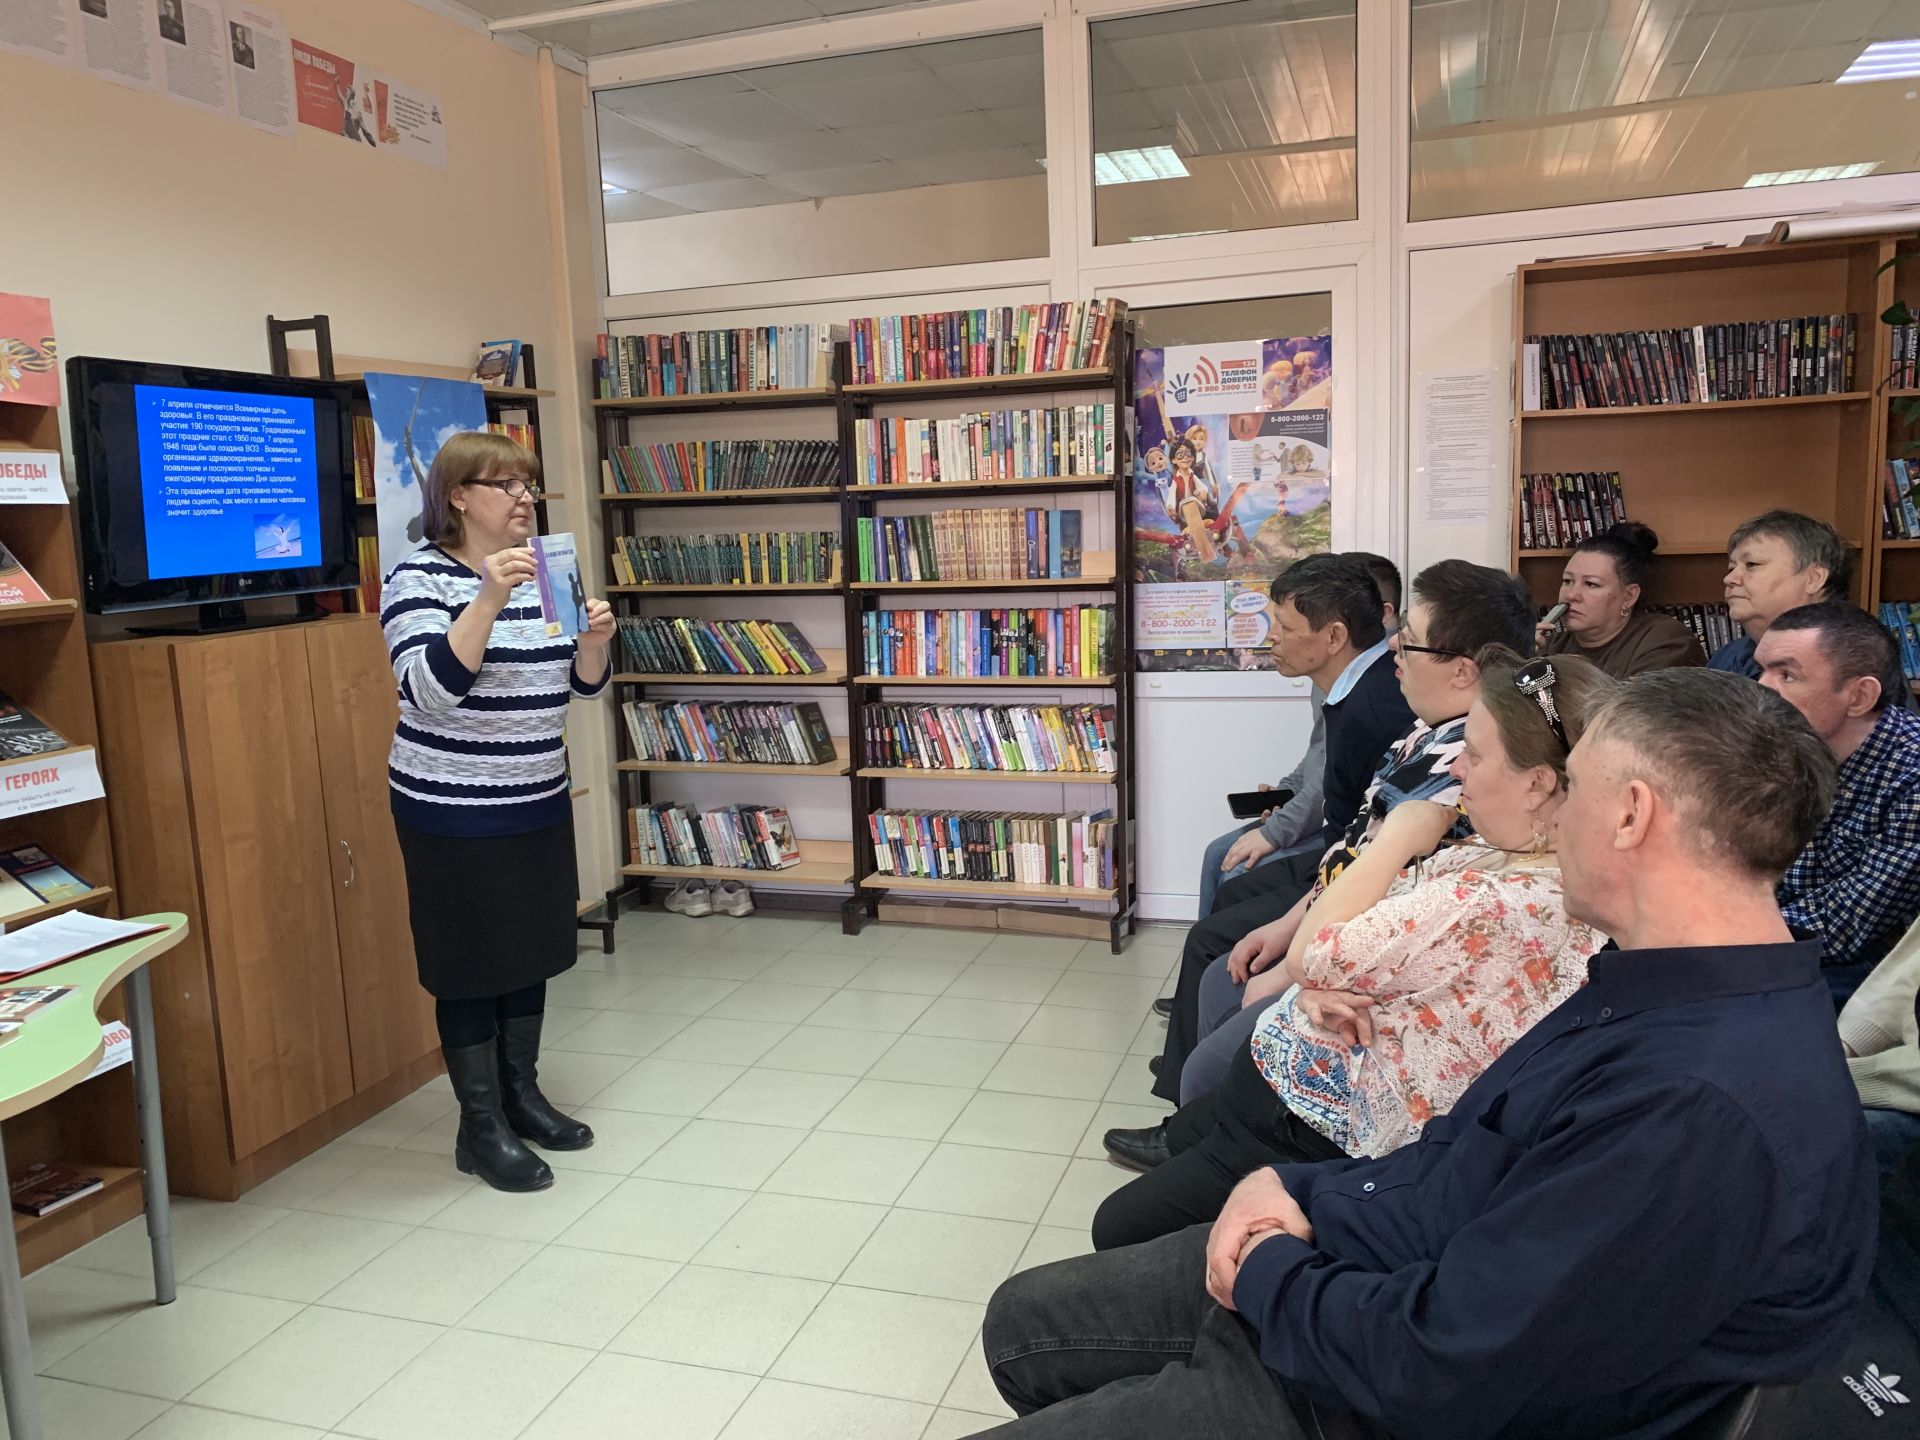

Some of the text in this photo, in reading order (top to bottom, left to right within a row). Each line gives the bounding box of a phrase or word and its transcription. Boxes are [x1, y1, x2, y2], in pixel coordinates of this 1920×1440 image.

[1221, 368, 1256, 376] ТЕЛЕФОН
[1221, 376, 1256, 384] ДОВЕРИЯ
[161, 398, 166, 406] 7
[168, 401, 194, 409] апреля
[194, 402, 234, 411] отмечается
[234, 404, 270, 414] Всемирный
[196, 412, 202, 420] В
[216, 415, 260, 423] праздновании
[1270, 414, 1324, 422] 8-800-2000-122
[160, 422, 188, 430] участие
[191, 422, 203, 430] 190
[204, 424, 240, 432] государств
[262, 425, 306, 434] Традиционным
[178, 434, 210, 442] праздник
[198, 443, 216, 451] была
[246, 444, 260, 452] ВОЗ
[264, 445, 298, 454] Всемирная
[162, 454, 206, 462] организация
[208, 466, 244, 474] послужило
[164, 476, 206, 484] ежегодному
[256, 474, 268, 482] Дня
[166, 486, 178, 496] Эта
[166, 498, 190, 506] людям
[192, 508, 224, 517] здоровье
[1141, 619, 1216, 628] 8-800-2000-122
[5, 767, 60, 792] ГЕРОЯХ
[1842, 1376, 1884, 1417] adidas
